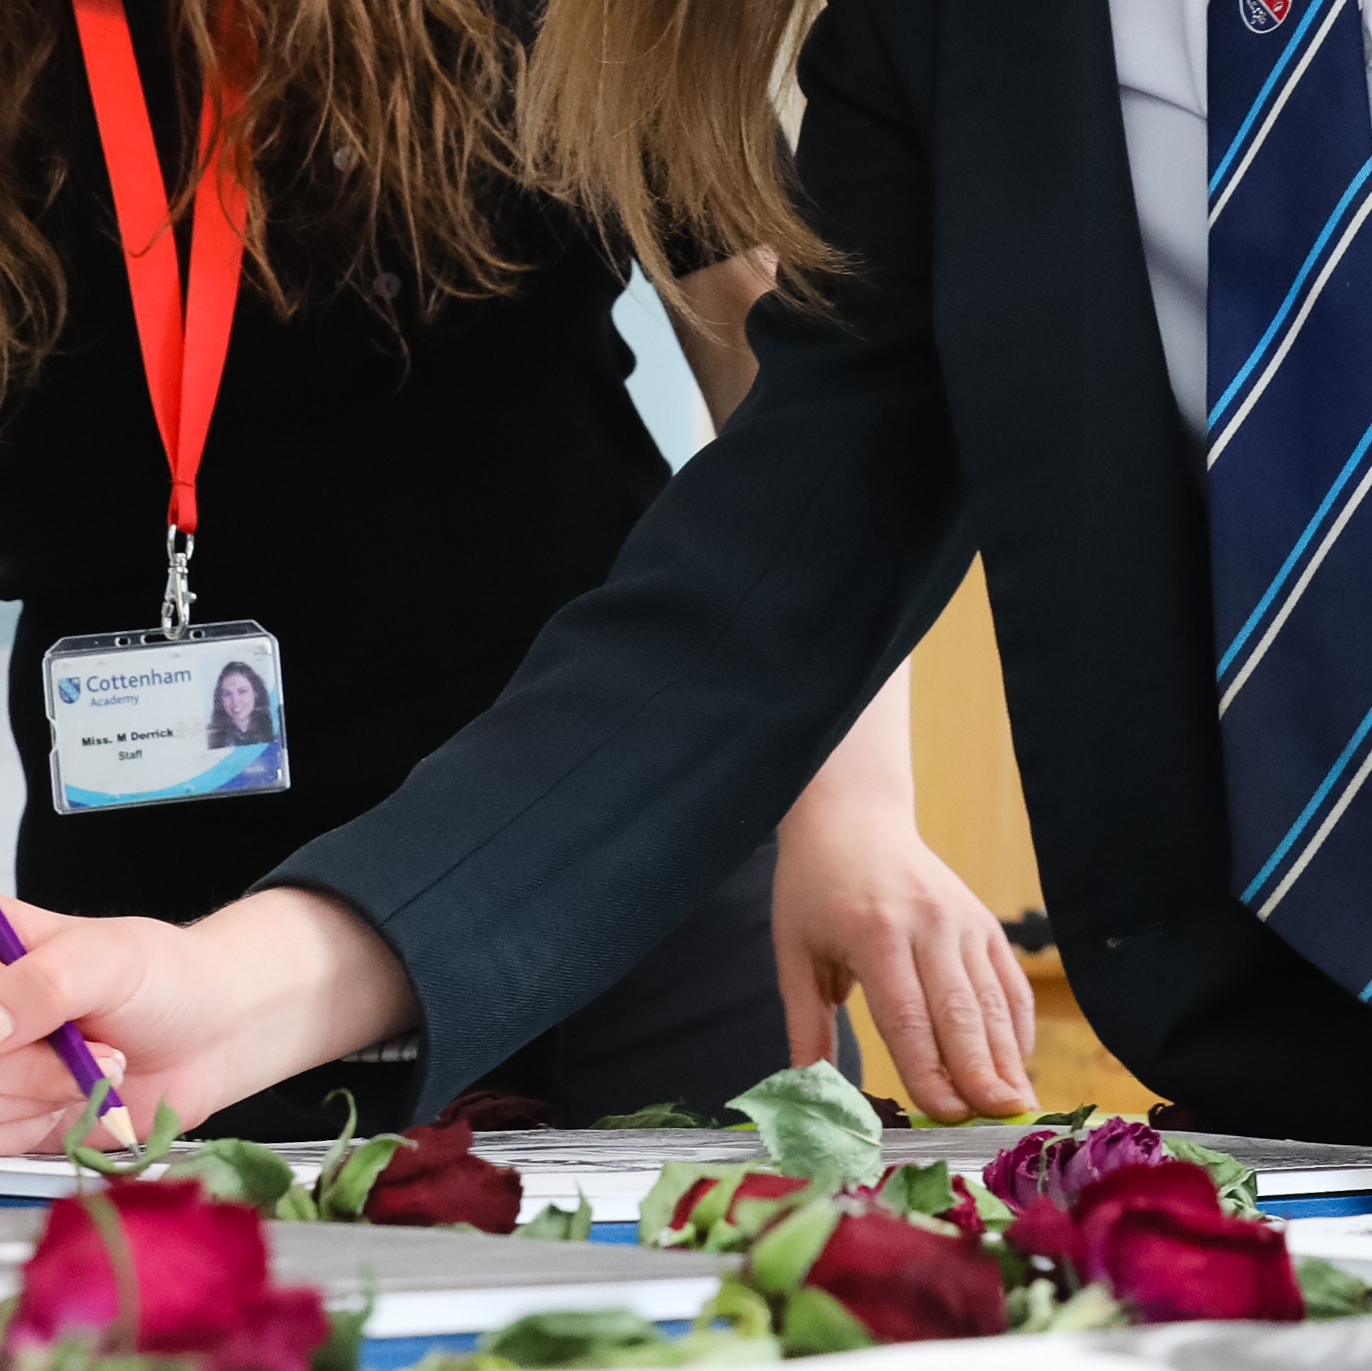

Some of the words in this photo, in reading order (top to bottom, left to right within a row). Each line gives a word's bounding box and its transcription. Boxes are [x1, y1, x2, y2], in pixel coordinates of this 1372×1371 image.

[86, 668, 192, 693] Cottenham
[90, 694, 140, 707] Academy
[82, 735, 113, 746] Miss.
[117, 732, 127, 742] M
[131, 728, 174, 741] Derrick
[118, 749, 143, 760] Staff
